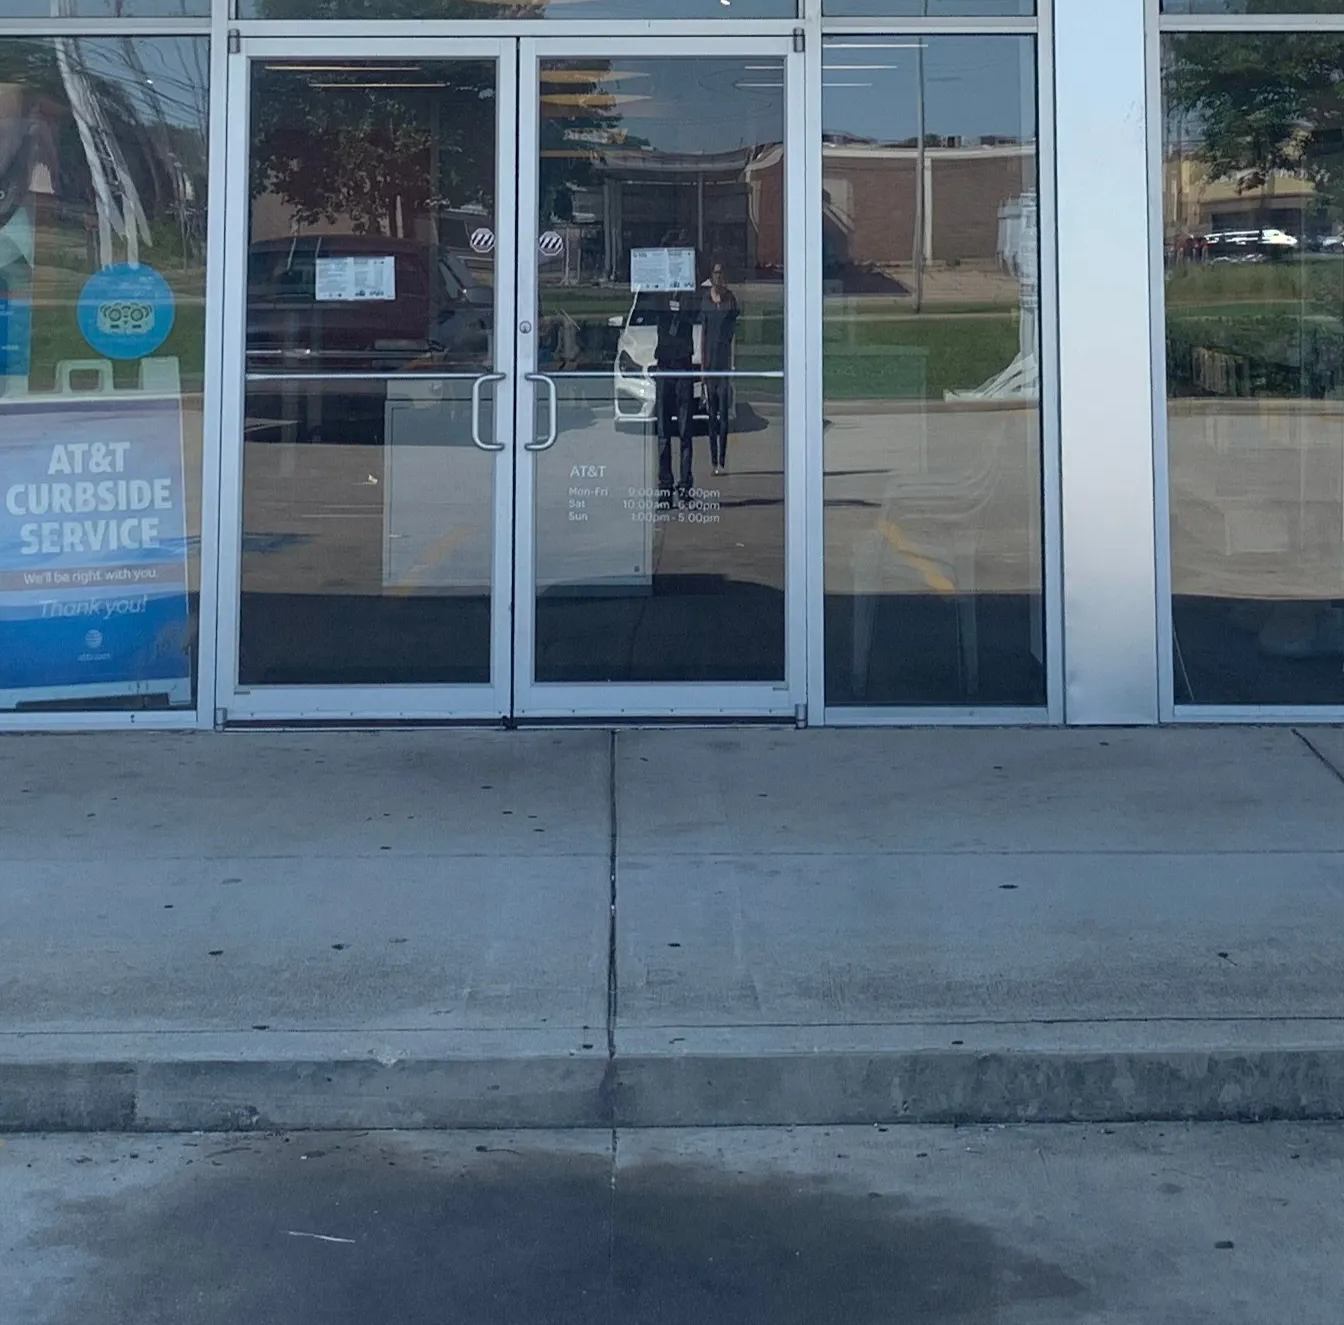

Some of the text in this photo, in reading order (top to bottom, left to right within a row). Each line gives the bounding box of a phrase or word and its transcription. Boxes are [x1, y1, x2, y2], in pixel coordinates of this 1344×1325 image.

[47, 442, 130, 475] AT&T
[569, 465, 607, 477] AT&T
[6, 478, 173, 516] CURBSIDE
[568, 487, 608, 497] Mon-Fri
[568, 499, 585, 508] Sat
[568, 511, 588, 521] Sun
[19, 517, 161, 556] SERVICE
[24, 571, 51, 585] We'll
[54, 571, 70, 584] be
[72, 569, 101, 585] right
[105, 568, 131, 581] with
[39, 594, 149, 620] Thank you!
